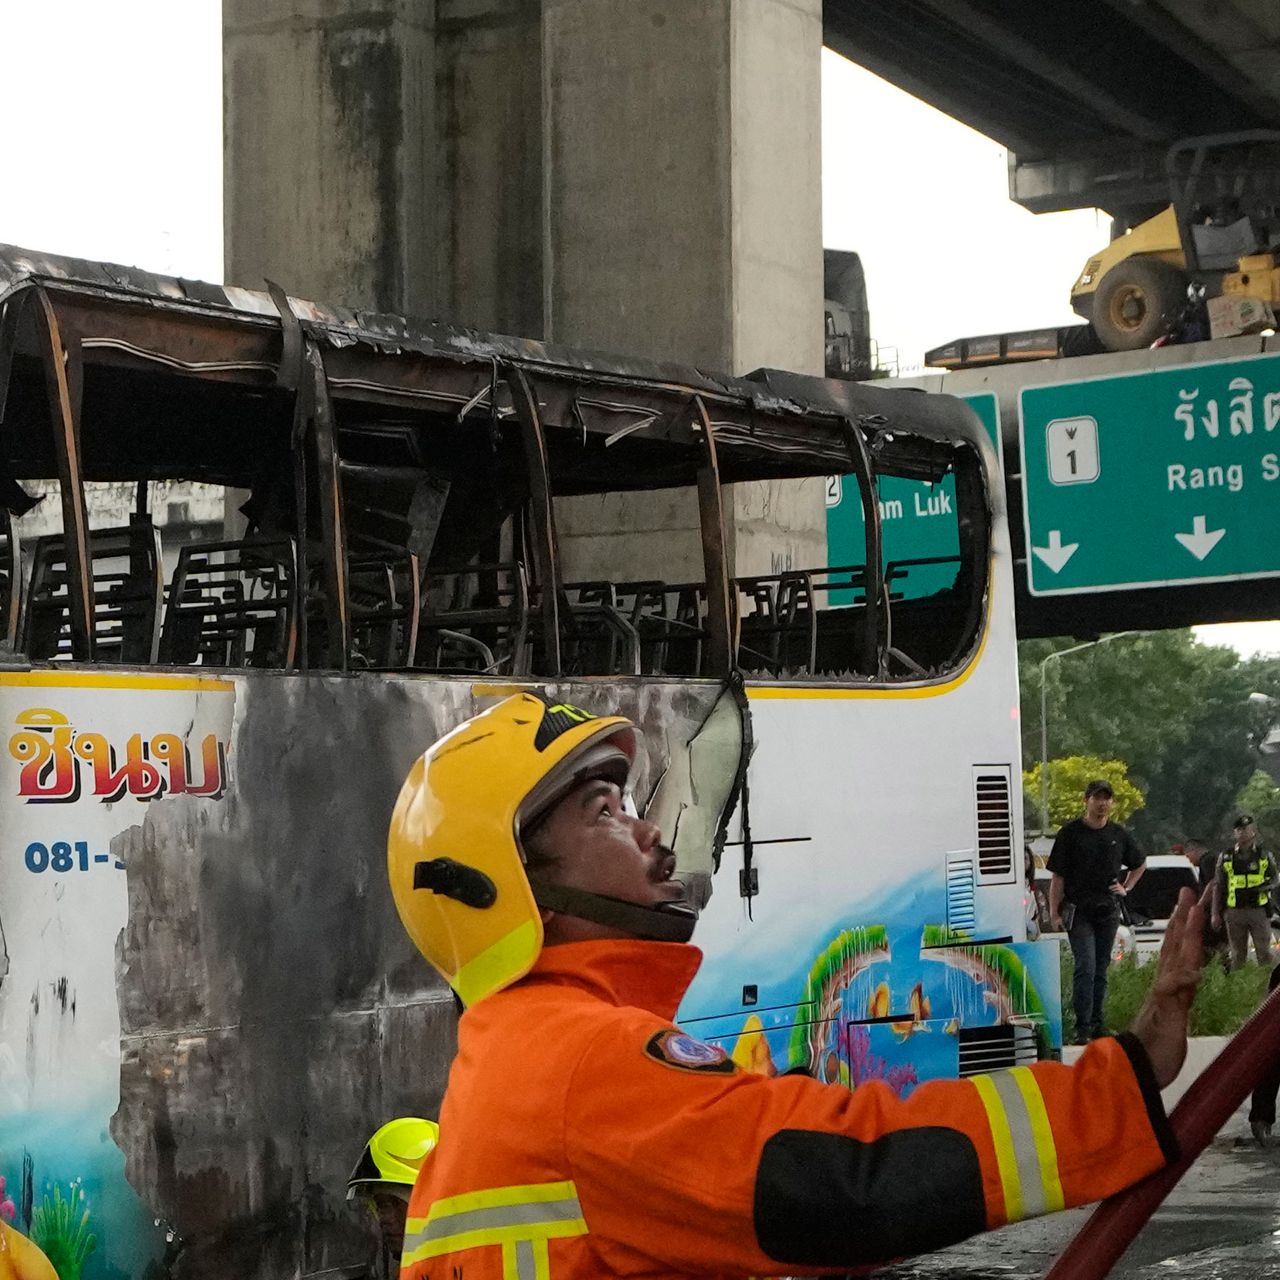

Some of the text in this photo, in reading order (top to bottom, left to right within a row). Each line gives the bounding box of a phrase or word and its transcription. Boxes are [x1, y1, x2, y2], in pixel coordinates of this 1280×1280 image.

[1066, 449, 1077, 475] 1
[1167, 464, 1244, 492] Rang
[914, 490, 952, 517] Luk
